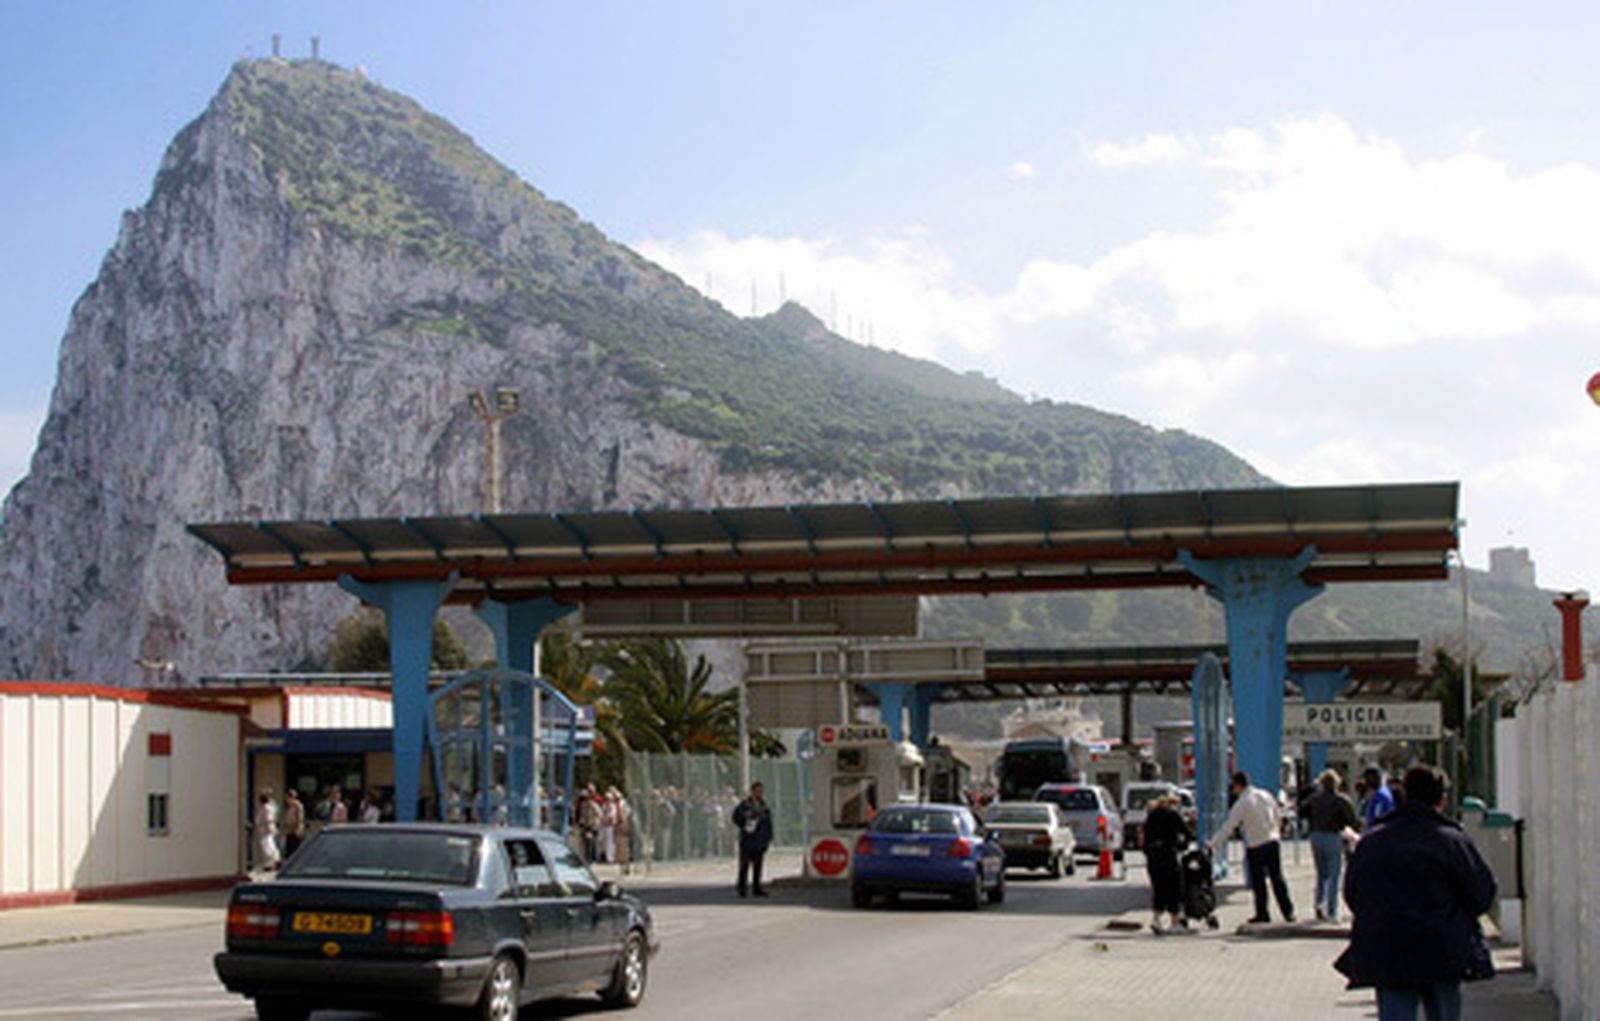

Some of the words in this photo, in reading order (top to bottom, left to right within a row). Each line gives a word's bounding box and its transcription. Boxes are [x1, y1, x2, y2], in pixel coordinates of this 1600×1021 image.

[1306, 706, 1387, 723] POLICIA
[840, 727, 888, 740] ADUANA
[1330, 724, 1347, 737] DE
[815, 851, 846, 862] STOP
